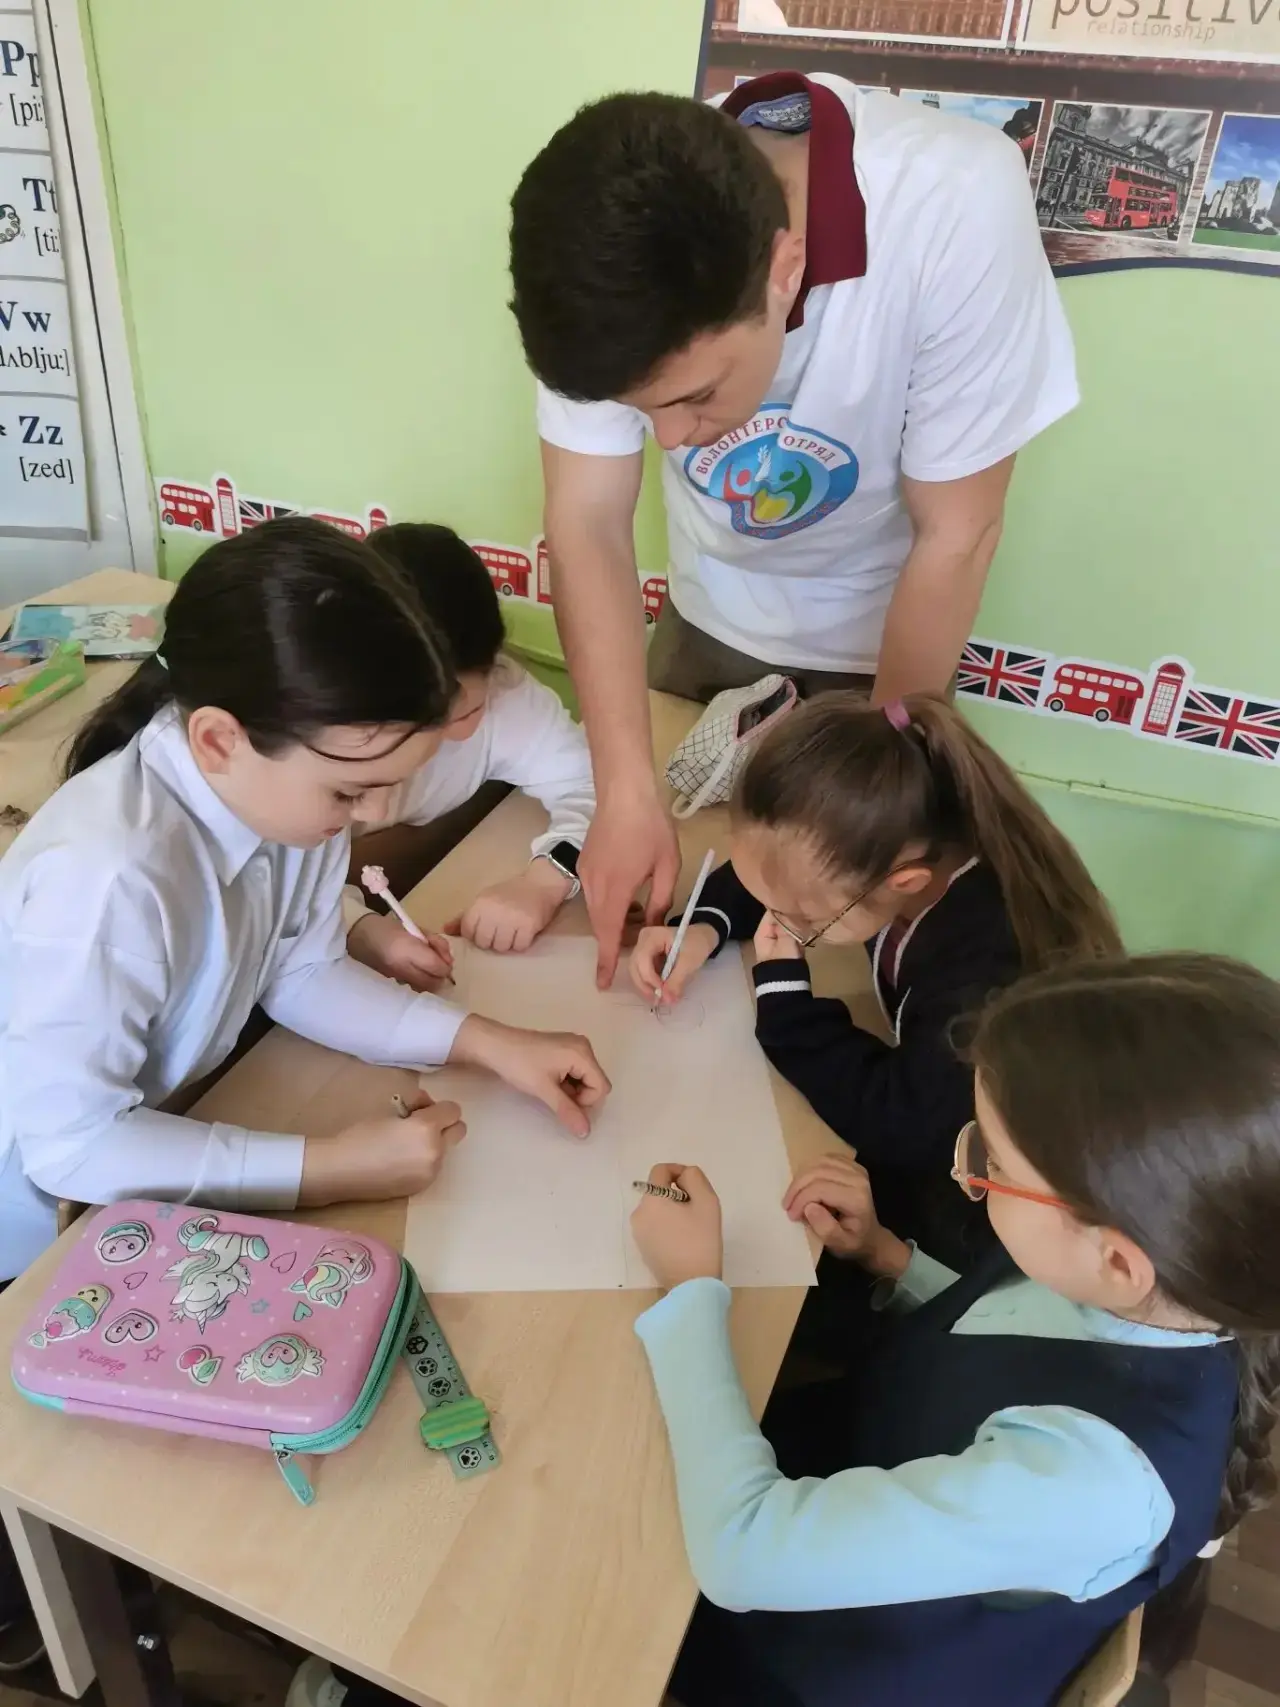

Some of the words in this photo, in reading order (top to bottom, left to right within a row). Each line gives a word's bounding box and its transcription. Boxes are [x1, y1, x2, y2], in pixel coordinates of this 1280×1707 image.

[1051, 0, 1280, 30] positiv
[1086, 18, 1216, 43] relationship
[19, 415, 64, 445] Zz
[783, 435, 836, 464] ОТРЯД
[19, 456, 75, 484] [zed]
